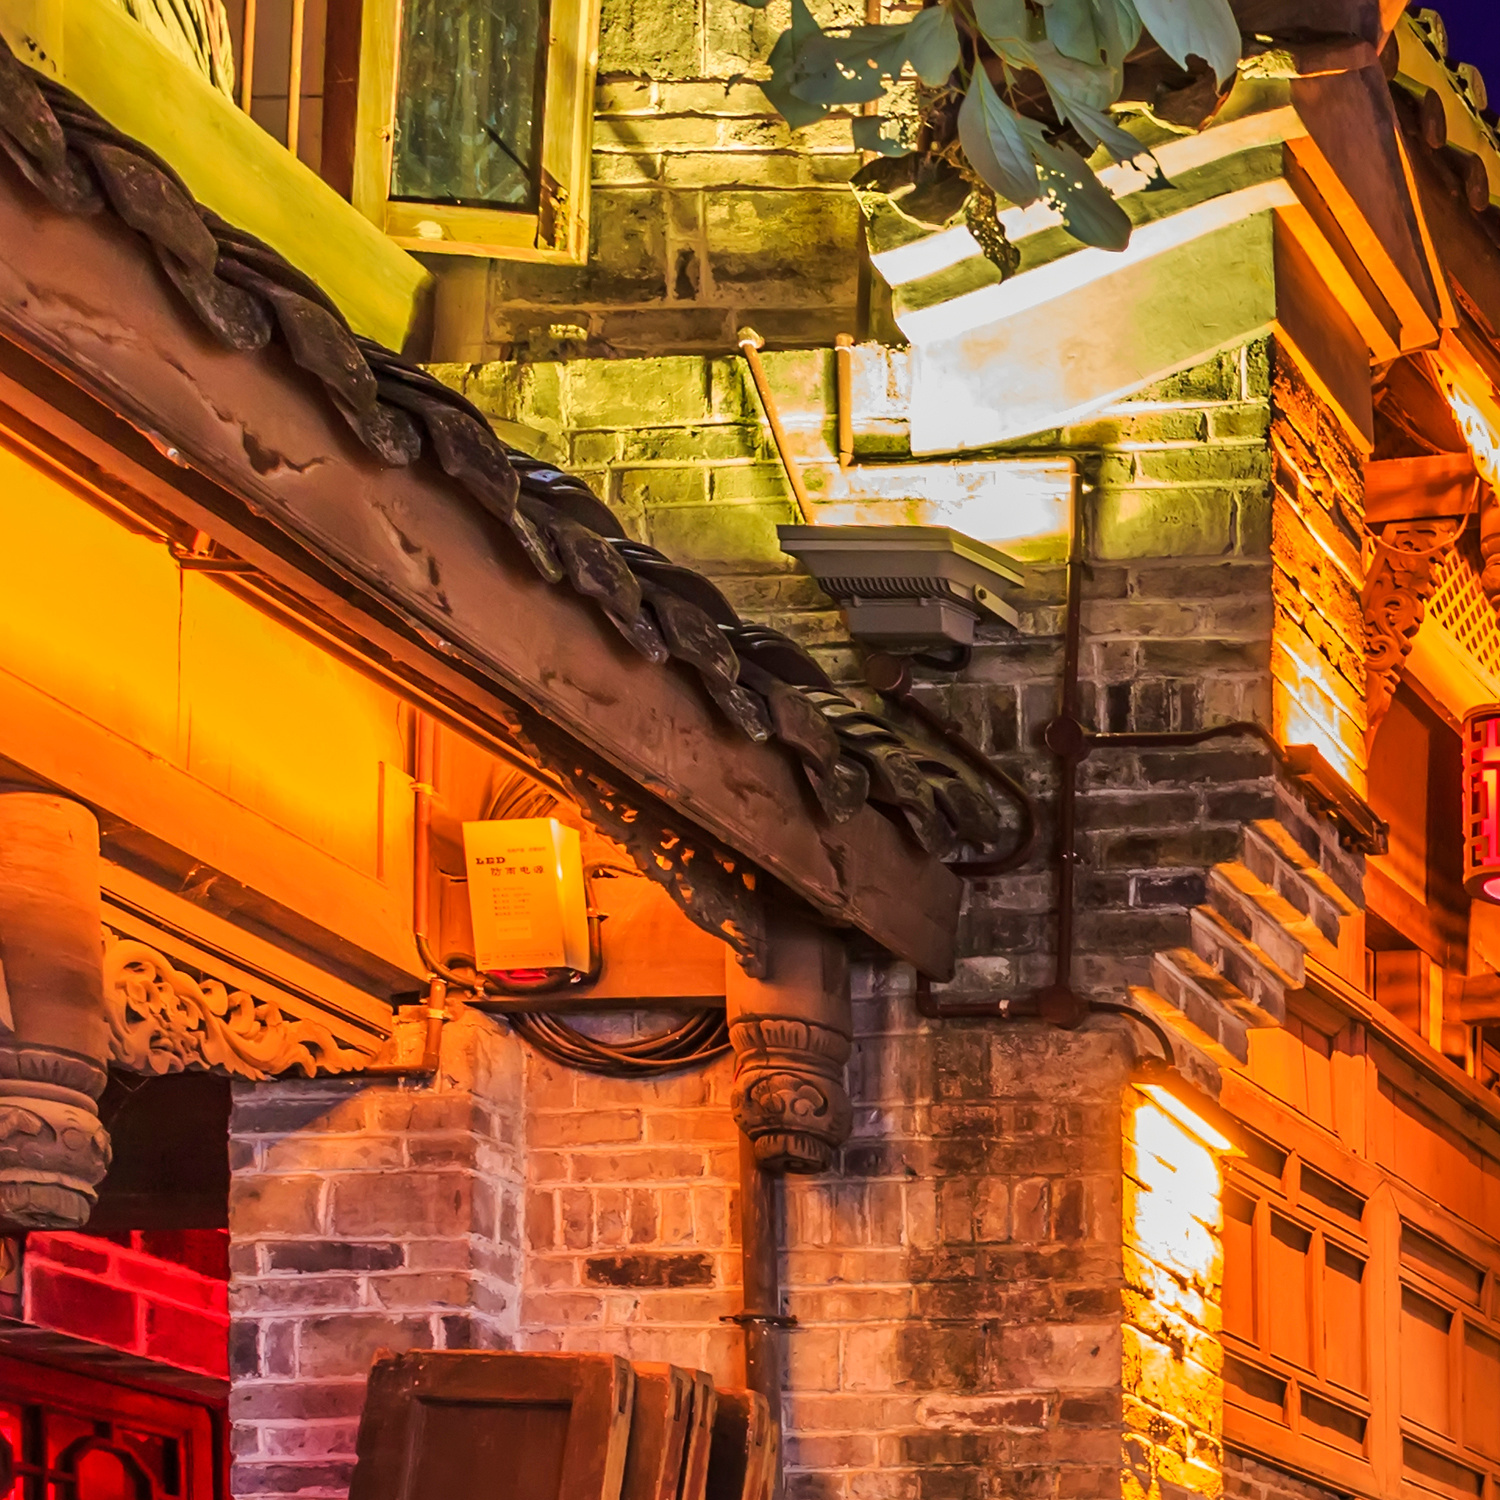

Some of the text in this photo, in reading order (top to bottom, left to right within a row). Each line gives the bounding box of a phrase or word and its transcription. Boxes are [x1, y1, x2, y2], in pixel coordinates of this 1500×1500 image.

[475, 856, 506, 865] LED
[490, 865, 544, 877] 防雨电源
